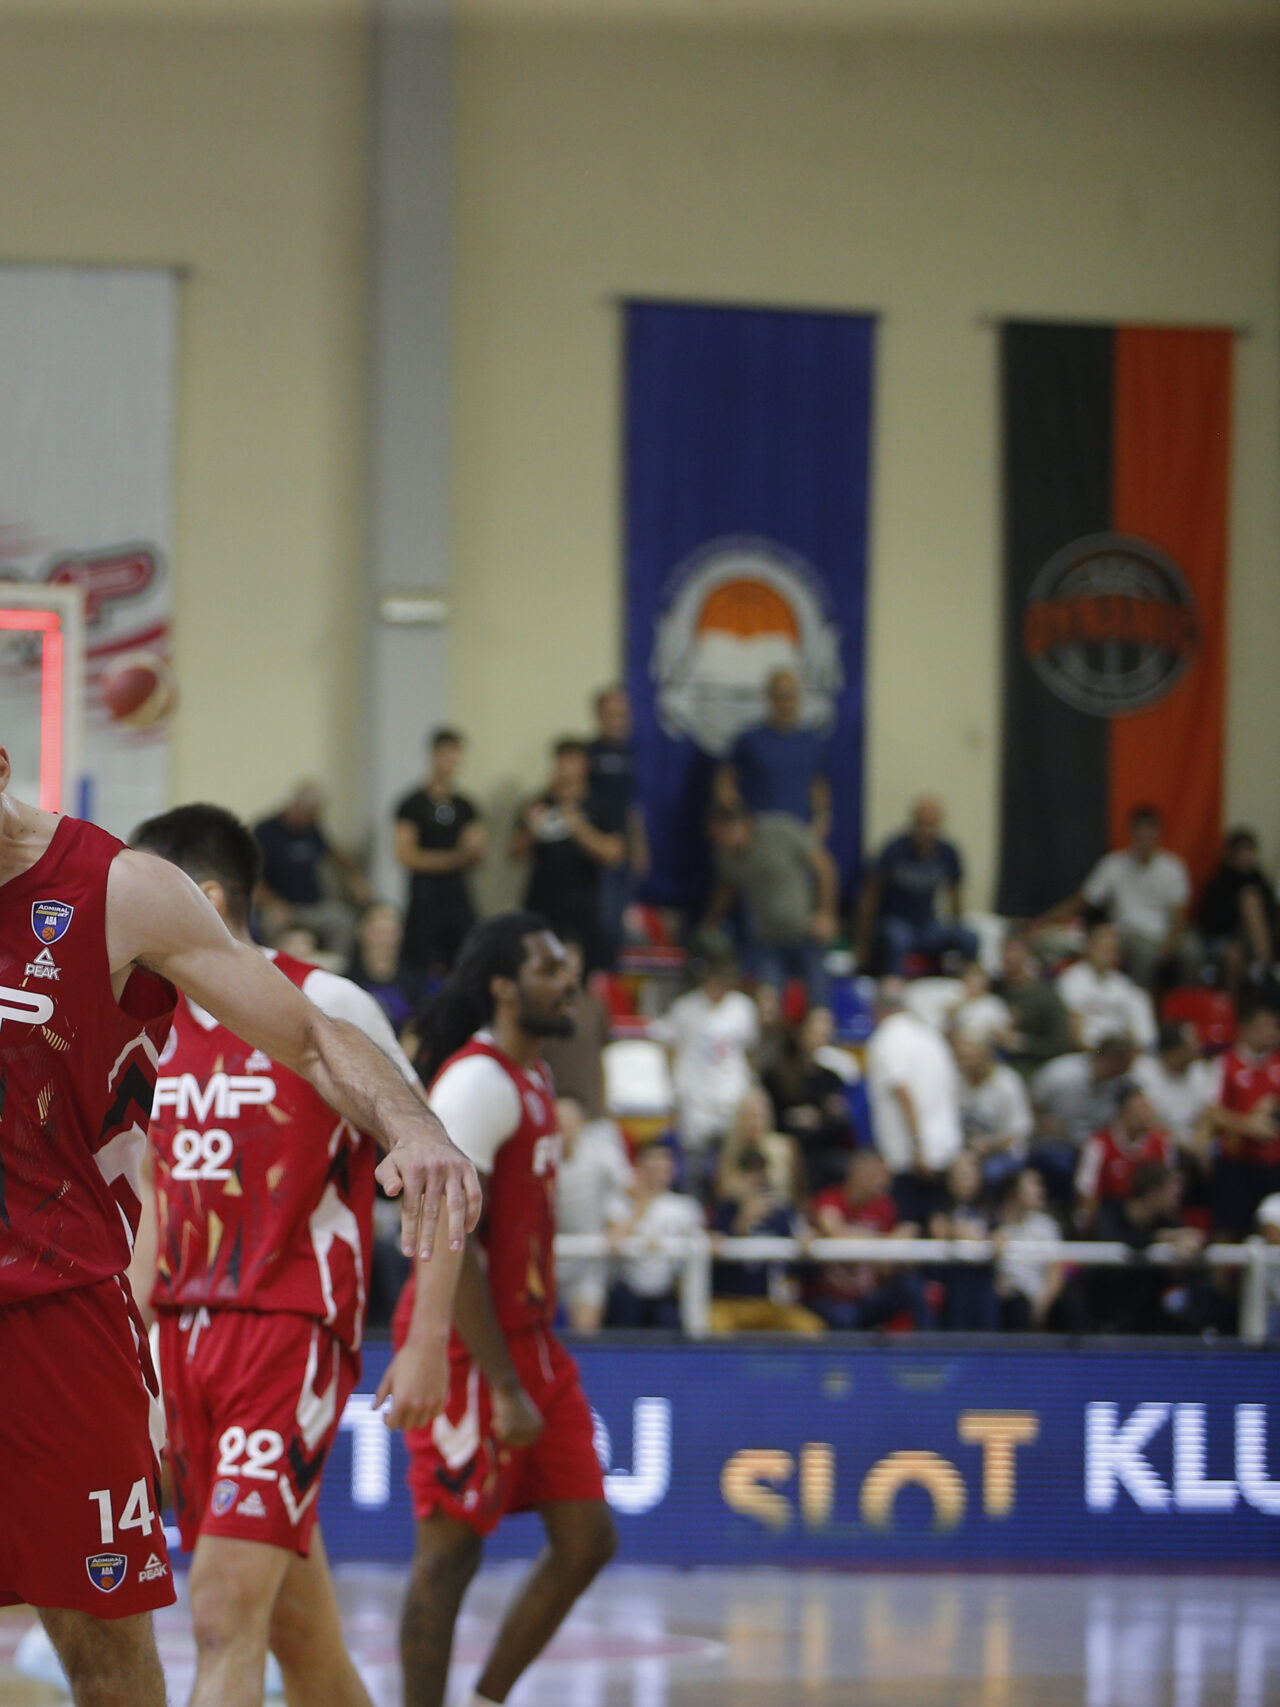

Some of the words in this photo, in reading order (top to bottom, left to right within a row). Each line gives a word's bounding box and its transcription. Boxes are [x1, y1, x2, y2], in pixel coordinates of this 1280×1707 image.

[24, 962, 61, 981] PEAK
[150, 1072, 277, 1123] FMP
[172, 1129, 233, 1180] 22
[217, 1426, 284, 1481] 22
[88, 1477, 155, 1544] 14
[138, 1563, 168, 1583] PEAK
